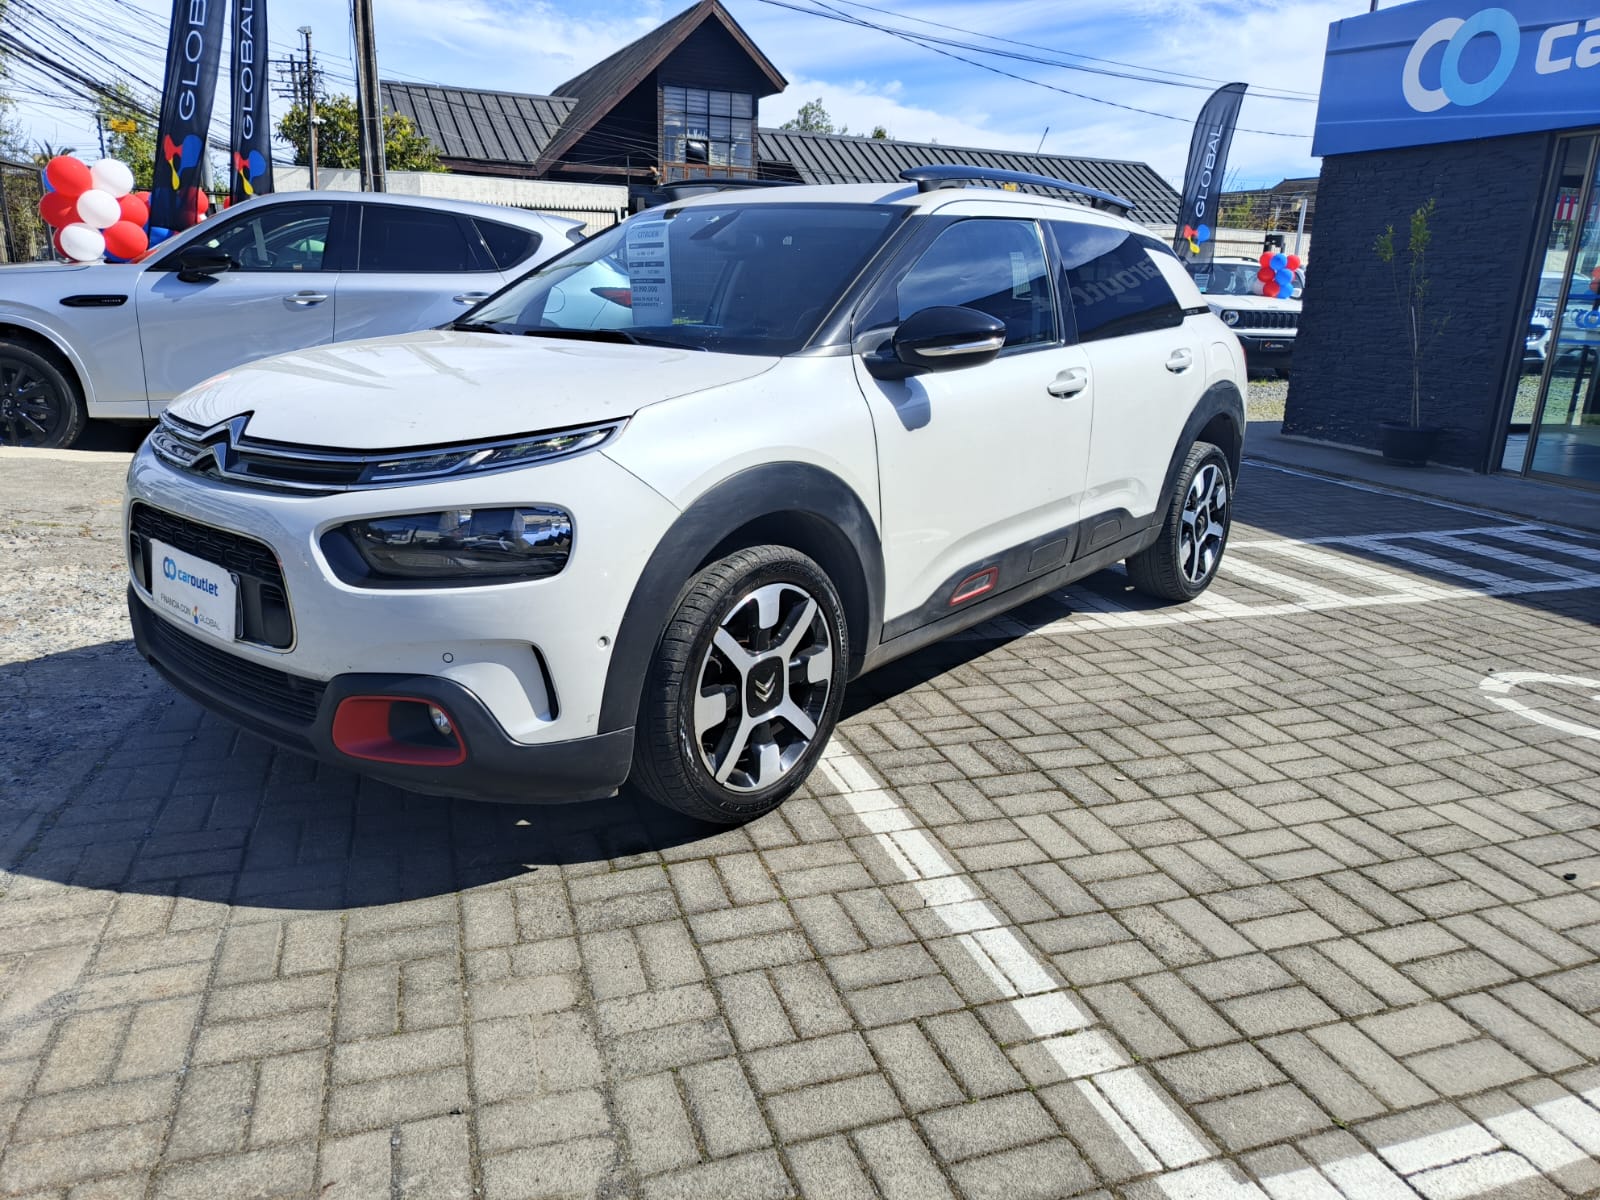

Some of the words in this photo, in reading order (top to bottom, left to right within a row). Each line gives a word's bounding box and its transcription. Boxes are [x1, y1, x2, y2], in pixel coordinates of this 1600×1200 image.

[180, 0, 206, 120] GLOB
[1195, 125, 1223, 218] GLOBAL
[177, 570, 219, 597] caroutlet
[198, 614, 221, 631] GLOBAL
